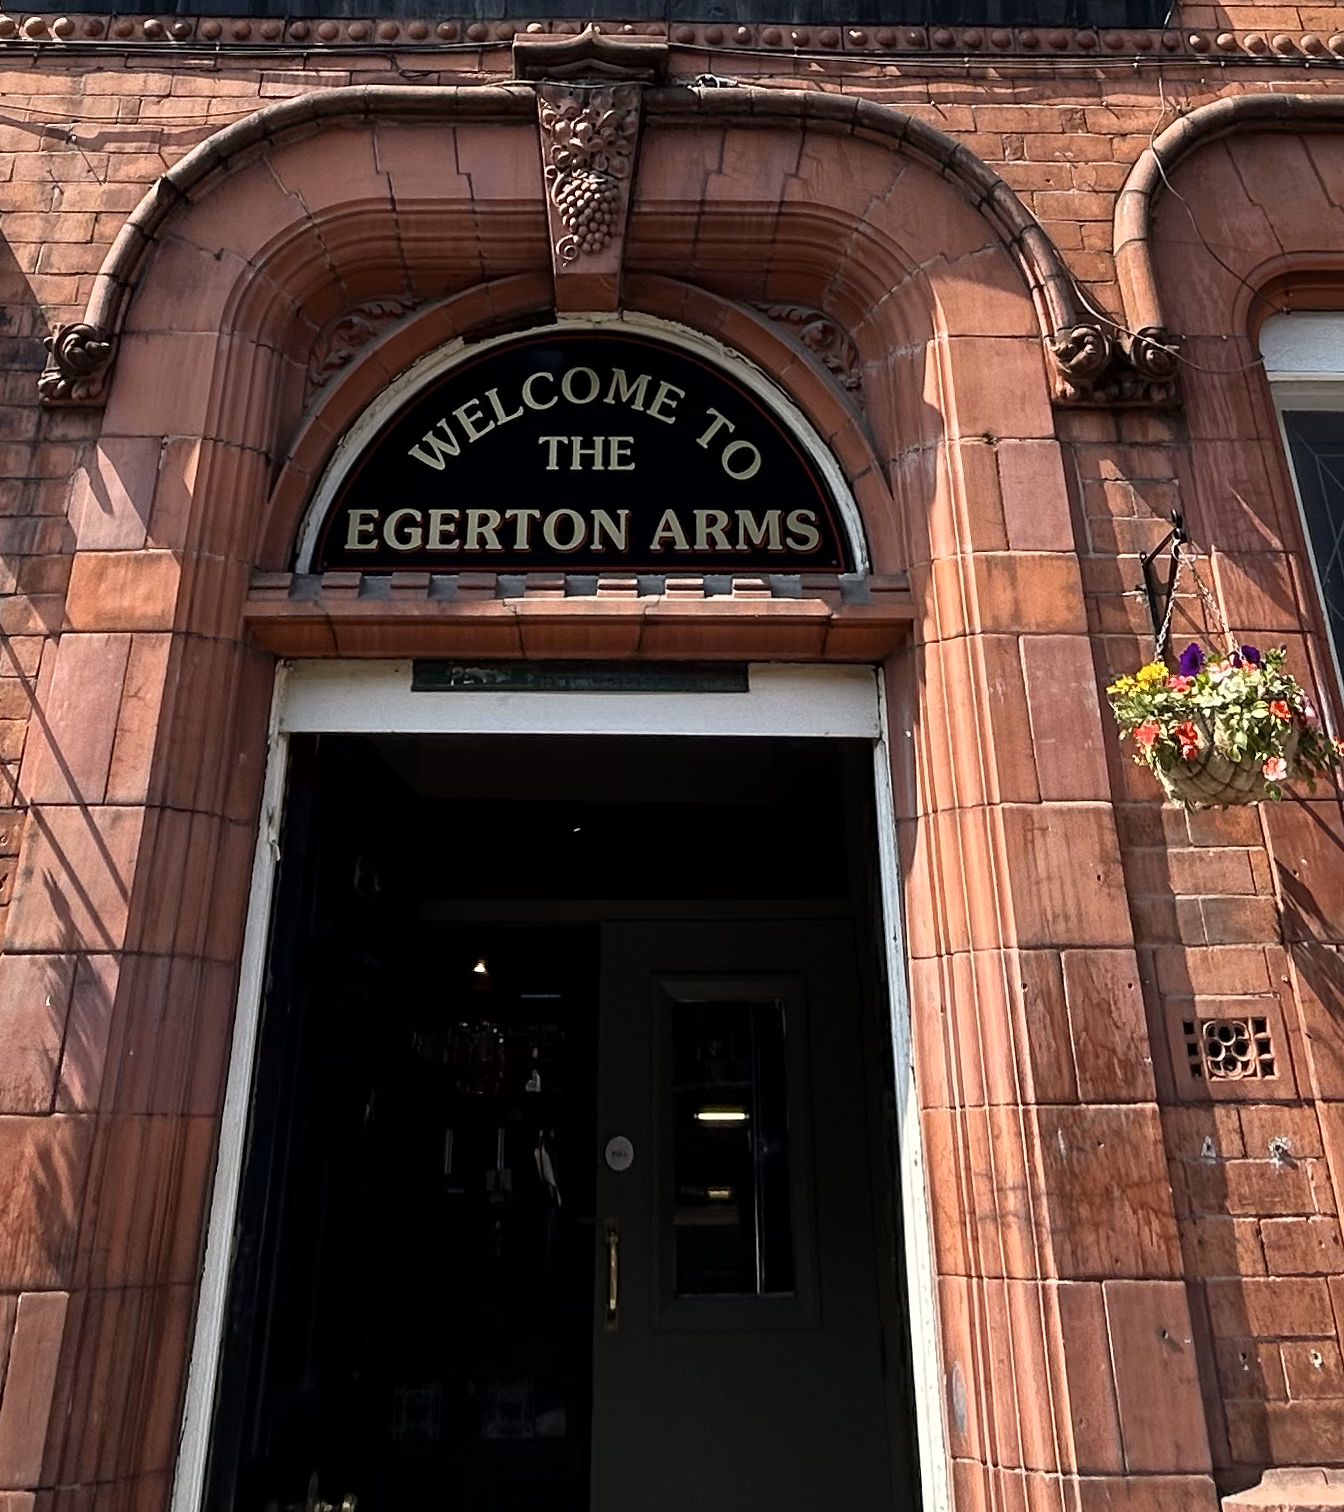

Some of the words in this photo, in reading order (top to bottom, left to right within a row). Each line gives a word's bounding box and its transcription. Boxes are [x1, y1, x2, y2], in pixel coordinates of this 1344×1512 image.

[407, 366, 686, 472] WELCOME
[695, 407, 763, 481] TO
[538, 435, 637, 471] THE
[343, 508, 629, 552] EGERTON
[649, 508, 821, 552] ARMS
